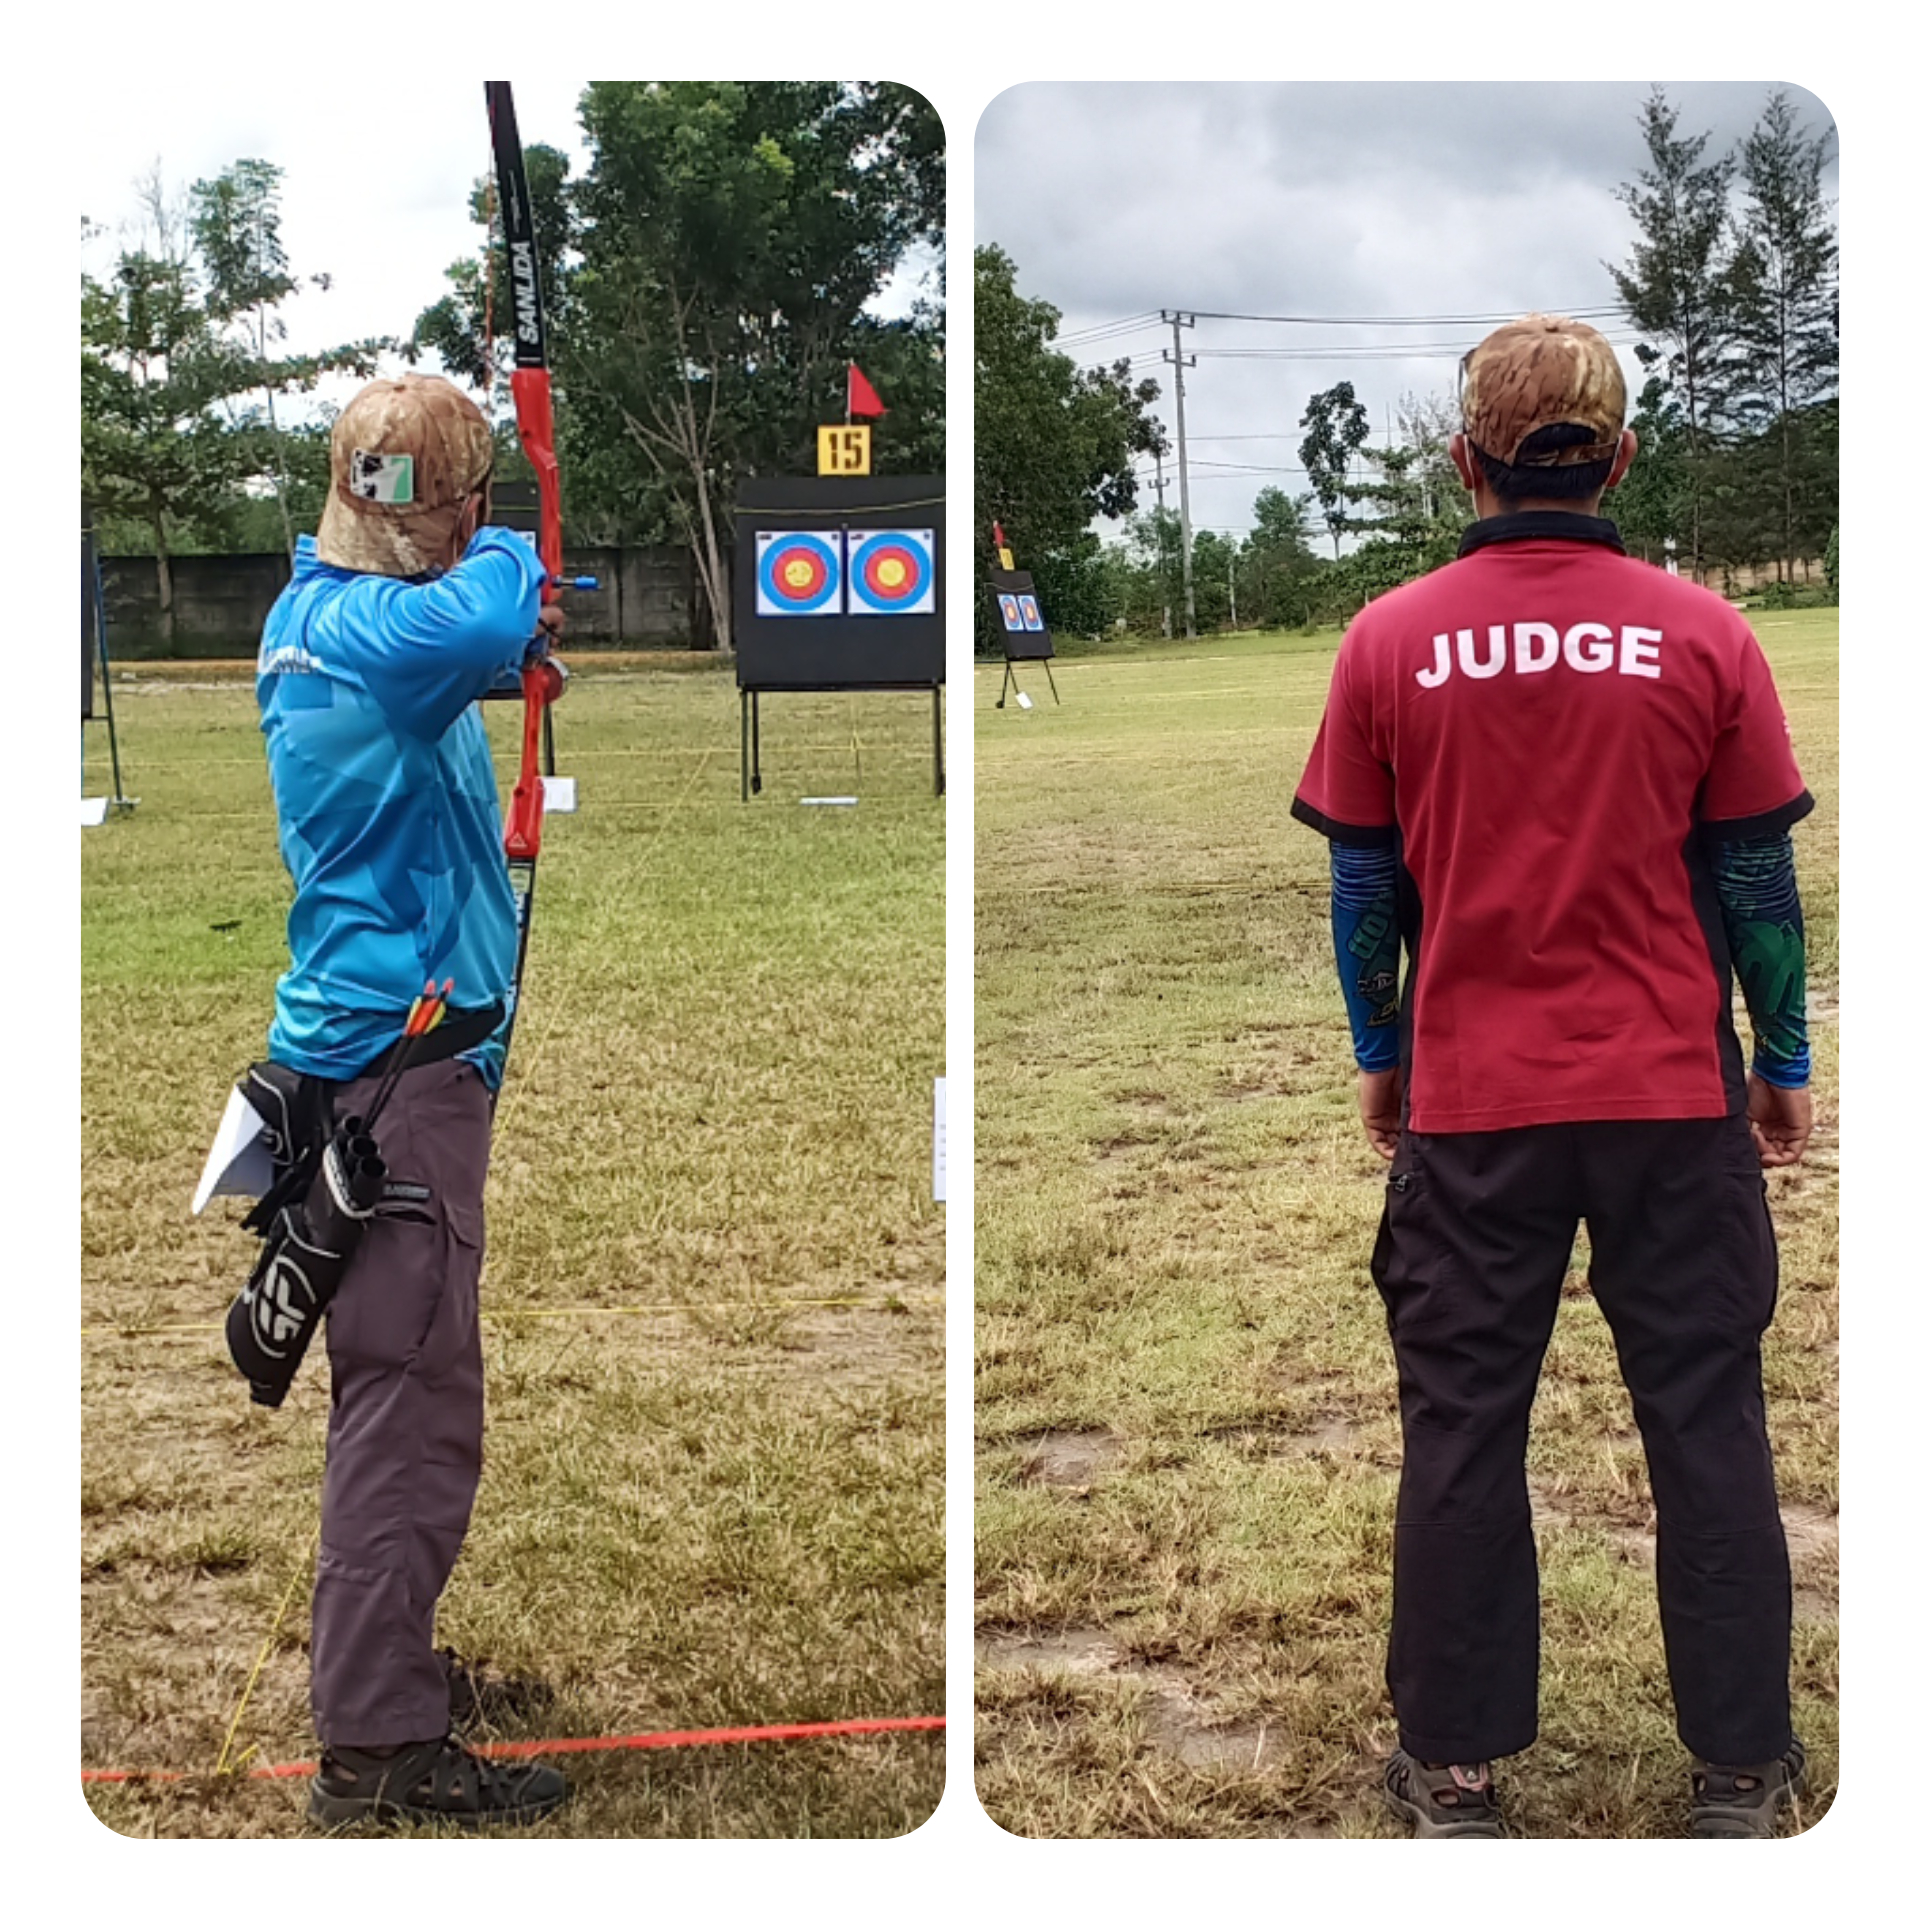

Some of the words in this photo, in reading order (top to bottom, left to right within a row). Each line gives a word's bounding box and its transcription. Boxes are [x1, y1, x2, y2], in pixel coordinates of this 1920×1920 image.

[511, 240, 538, 345] SANLIDA
[828, 431, 862, 470] 15
[1415, 621, 1663, 689] JUDGE
